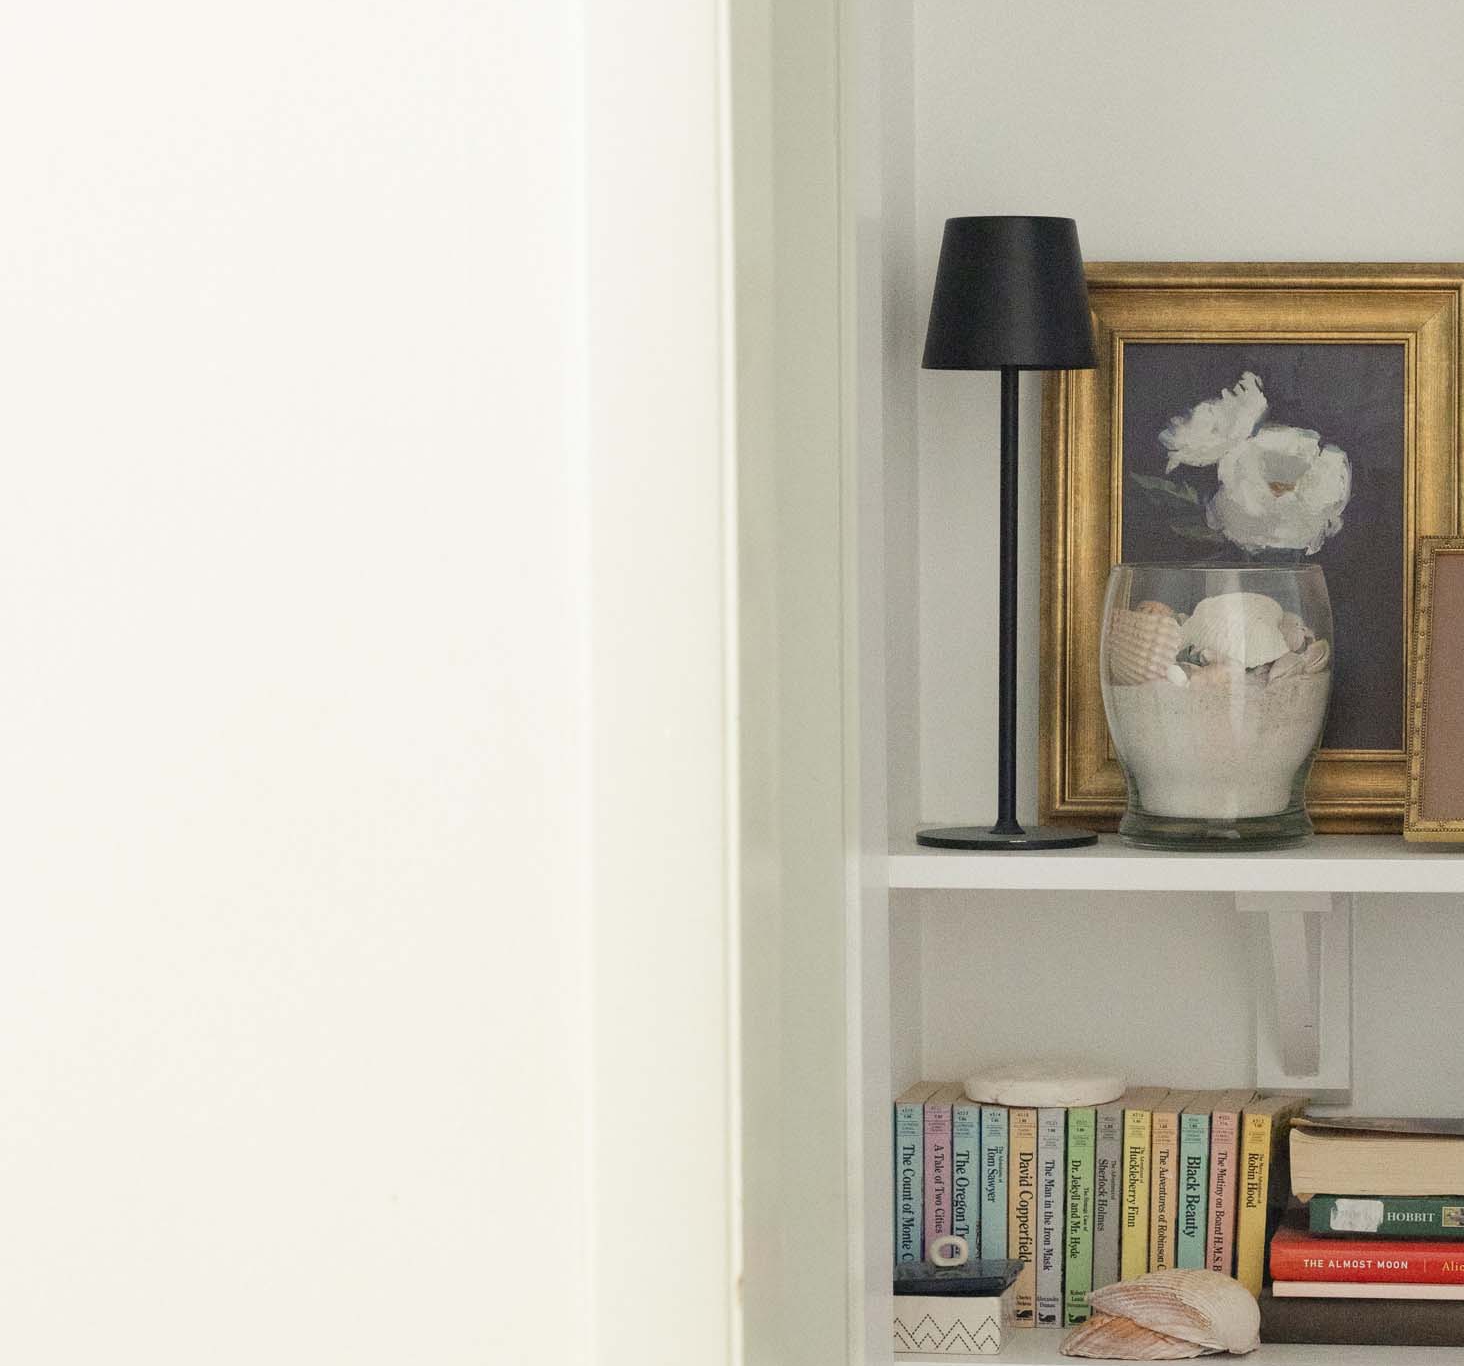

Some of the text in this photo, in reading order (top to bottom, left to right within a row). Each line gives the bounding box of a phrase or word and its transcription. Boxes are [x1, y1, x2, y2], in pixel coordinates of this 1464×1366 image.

[902, 1145, 915, 1165] The
[956, 1150, 969, 1174] The
[988, 1146, 998, 1167] Tom
[1019, 1152, 1034, 1186] David
[1159, 1149, 1169, 1165] The
[1217, 1151, 1228, 1165] The
[1247, 1153, 1259, 1179] Robin
[902, 1168, 915, 1202] Count
[986, 1168, 998, 1202] Sawyer
[1127, 1146, 1141, 1204] Huckleberry
[1187, 1155, 1201, 1191] Black
[1215, 1168, 1226, 1196] Mutiny
[935, 1153, 945, 1234] Tale Two Cities
[953, 1177, 969, 1222] Oregon
[1097, 1159, 1108, 1232] Sherlock Holmes
[1158, 1167, 1169, 1213] Adventures
[1246, 1183, 1258, 1208] Hood
[902, 1204, 914, 1215] of
[1043, 1160, 1055, 1271] The Man the Iron Mask
[1069, 1175, 1081, 1259] Jekyll and Hyde
[1128, 1206, 1139, 1227] Finn
[1183, 1194, 1201, 1238] Beauty
[1215, 1210, 1225, 1234] Board
[1387, 1212, 1435, 1223] HOBBIT
[902, 1217, 914, 1250] Monte
[1016, 1190, 1034, 1263] Copperfield
[1157, 1225, 1167, 1262] Robinson
[1304, 1259, 1409, 1270] THE ALMOST MOON
